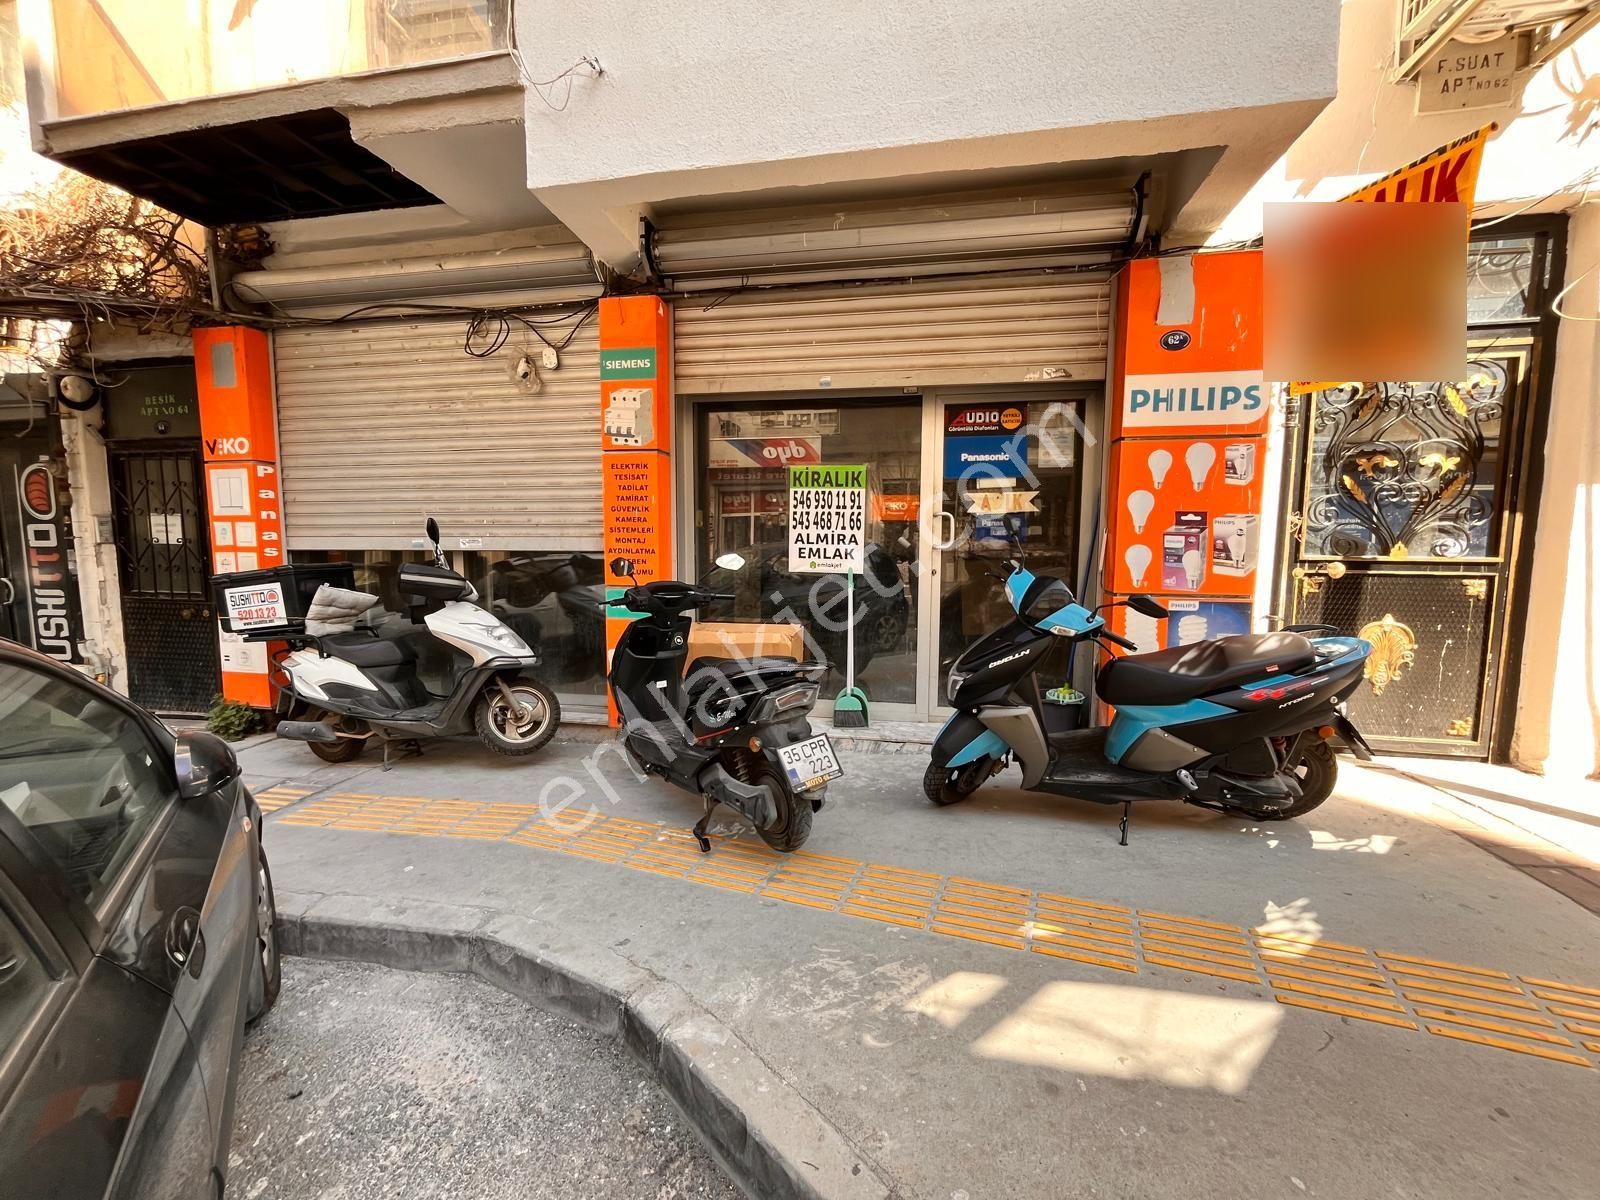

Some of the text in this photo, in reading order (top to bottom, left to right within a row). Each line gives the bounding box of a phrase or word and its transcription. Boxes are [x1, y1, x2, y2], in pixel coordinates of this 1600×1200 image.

[1476, 80, 1491, 90] NO
[1493, 79, 1509, 88] 62
[605, 359, 650, 369] SIEMENS
[1130, 385, 1261, 413] PHILIPS
[178, 404, 189, 414] 64
[951, 411, 1000, 426] AUDIO
[960, 452, 1010, 461] Panasonic
[611, 462, 648, 470] ELEKTRİK
[792, 466, 862, 487] KİRALIK
[793, 491, 862, 509] 546 930 11 91
[792, 511, 862, 530] 543 468 71 66
[794, 530, 859, 545] ALMİRA
[798, 547, 854, 559] EMLAK
[229, 591, 266, 607] SUSHITTO
[238, 606, 277, 620] 520 13 23
[783, 739, 828, 765] 35 CPR
[809, 755, 833, 774] 223
